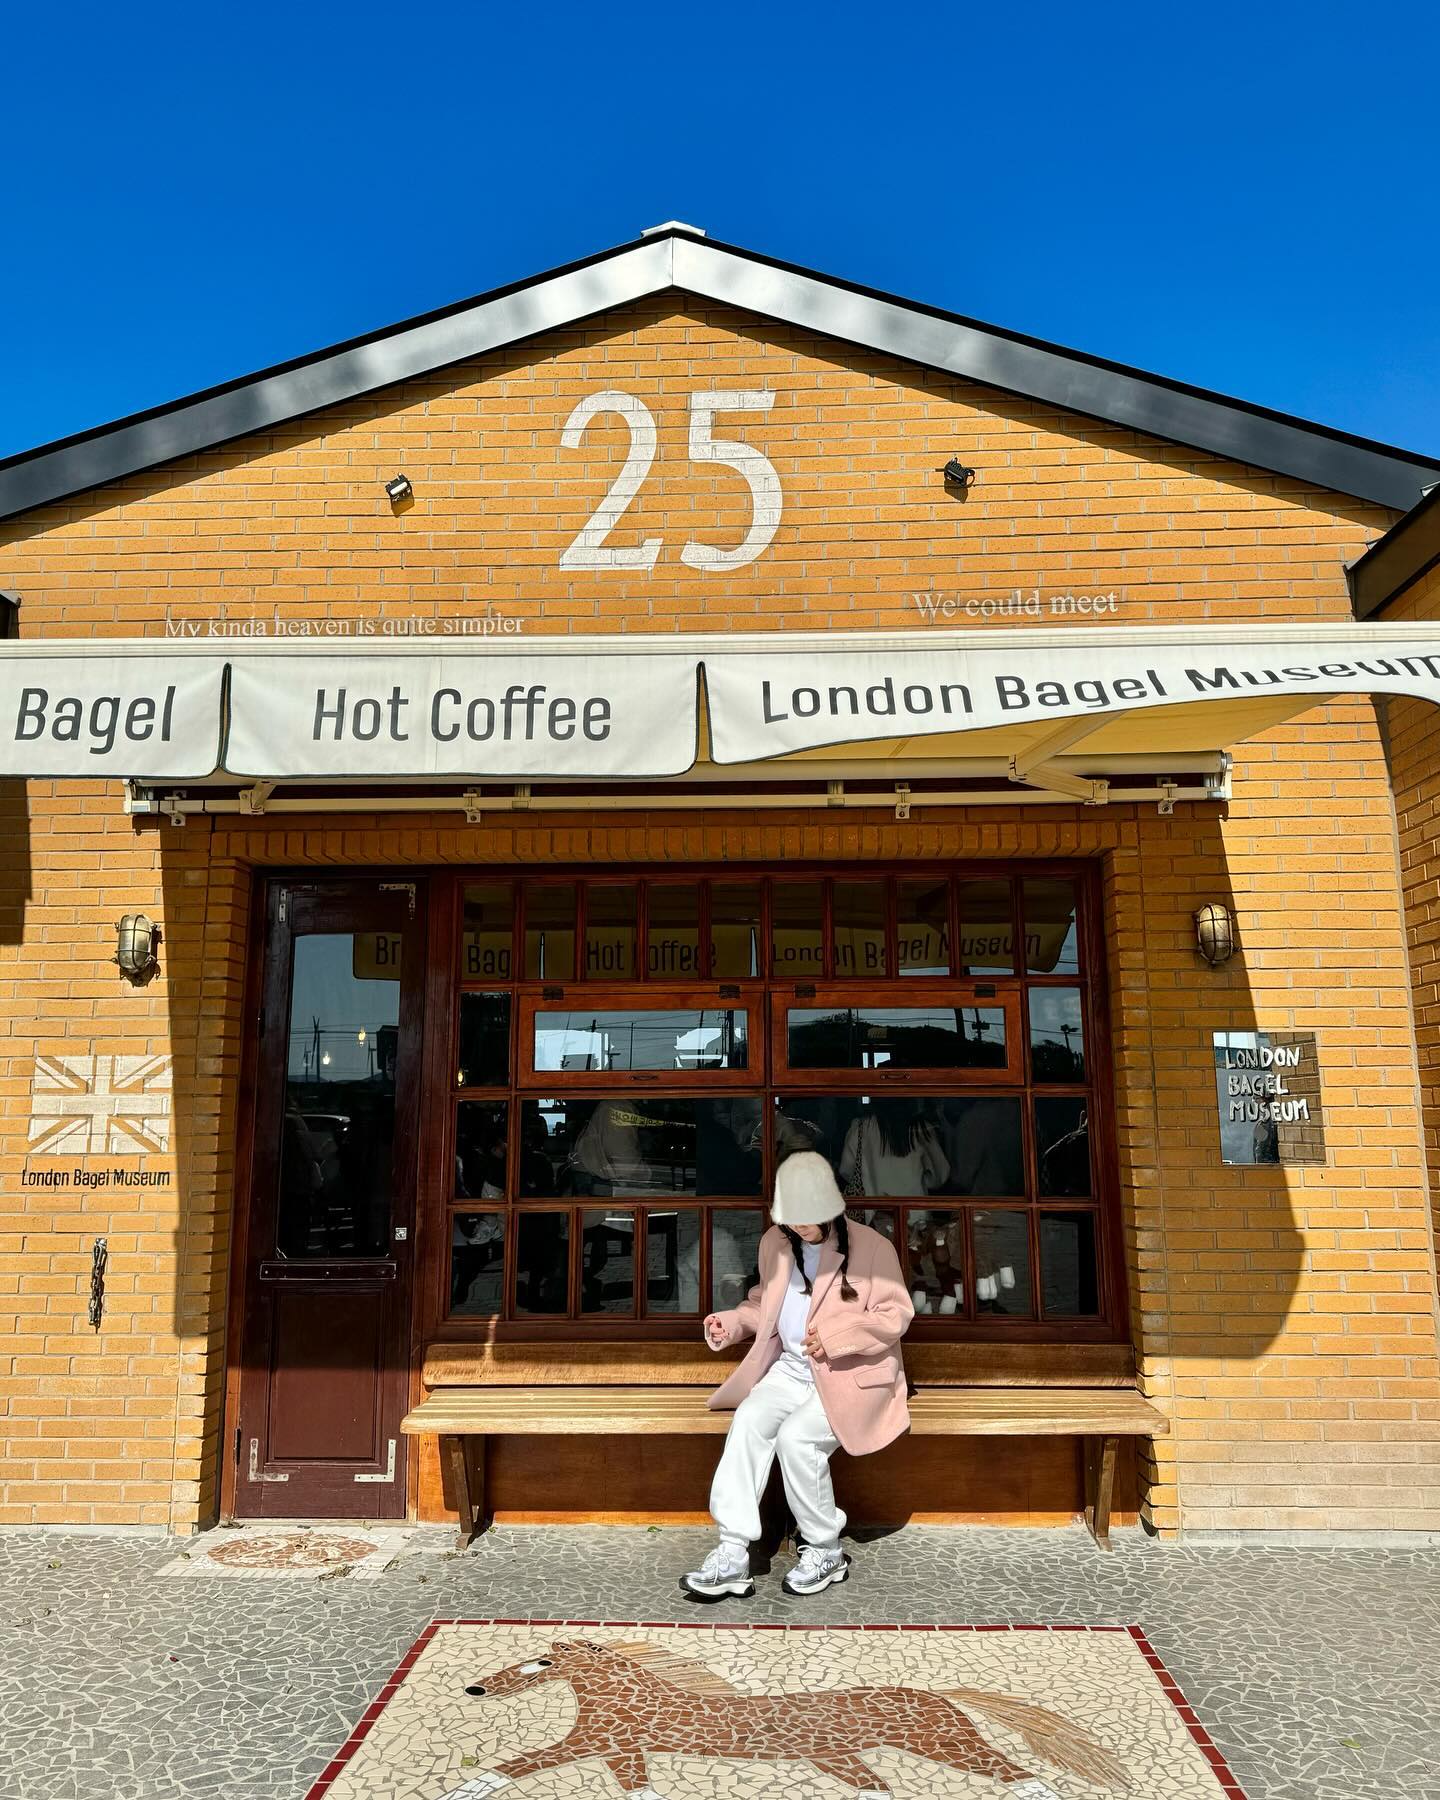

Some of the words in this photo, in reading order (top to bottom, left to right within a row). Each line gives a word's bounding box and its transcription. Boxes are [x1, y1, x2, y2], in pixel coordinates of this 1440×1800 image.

[559, 389, 783, 572] 25
[911, 593, 957, 618] We
[965, 590, 1041, 617] could
[1050, 591, 1119, 615] meet
[165, 617, 201, 637] My
[207, 616, 267, 637] kinda
[273, 615, 351, 636] heaven
[357, 614, 375, 635] is
[382, 614, 436, 637] quite
[443, 612, 525, 636] simpler
[762, 676, 974, 724] London
[994, 669, 1169, 708] Bagel
[1183, 654, 1440, 692] Museum
[14, 685, 176, 755] Bagel
[311, 686, 410, 742] Hot
[429, 684, 612, 742] Coffee
[587, 940, 625, 971] Hot
[633, 940, 717, 972] offee
[1225, 1046, 1301, 1070] LONDON
[1228, 1073, 1289, 1097] BAGEL
[1229, 1098, 1311, 1123] MUSEUM
[21, 1169, 69, 1187] London
[73, 1168, 110, 1190] Bagel
[113, 1168, 170, 1187] Museum
